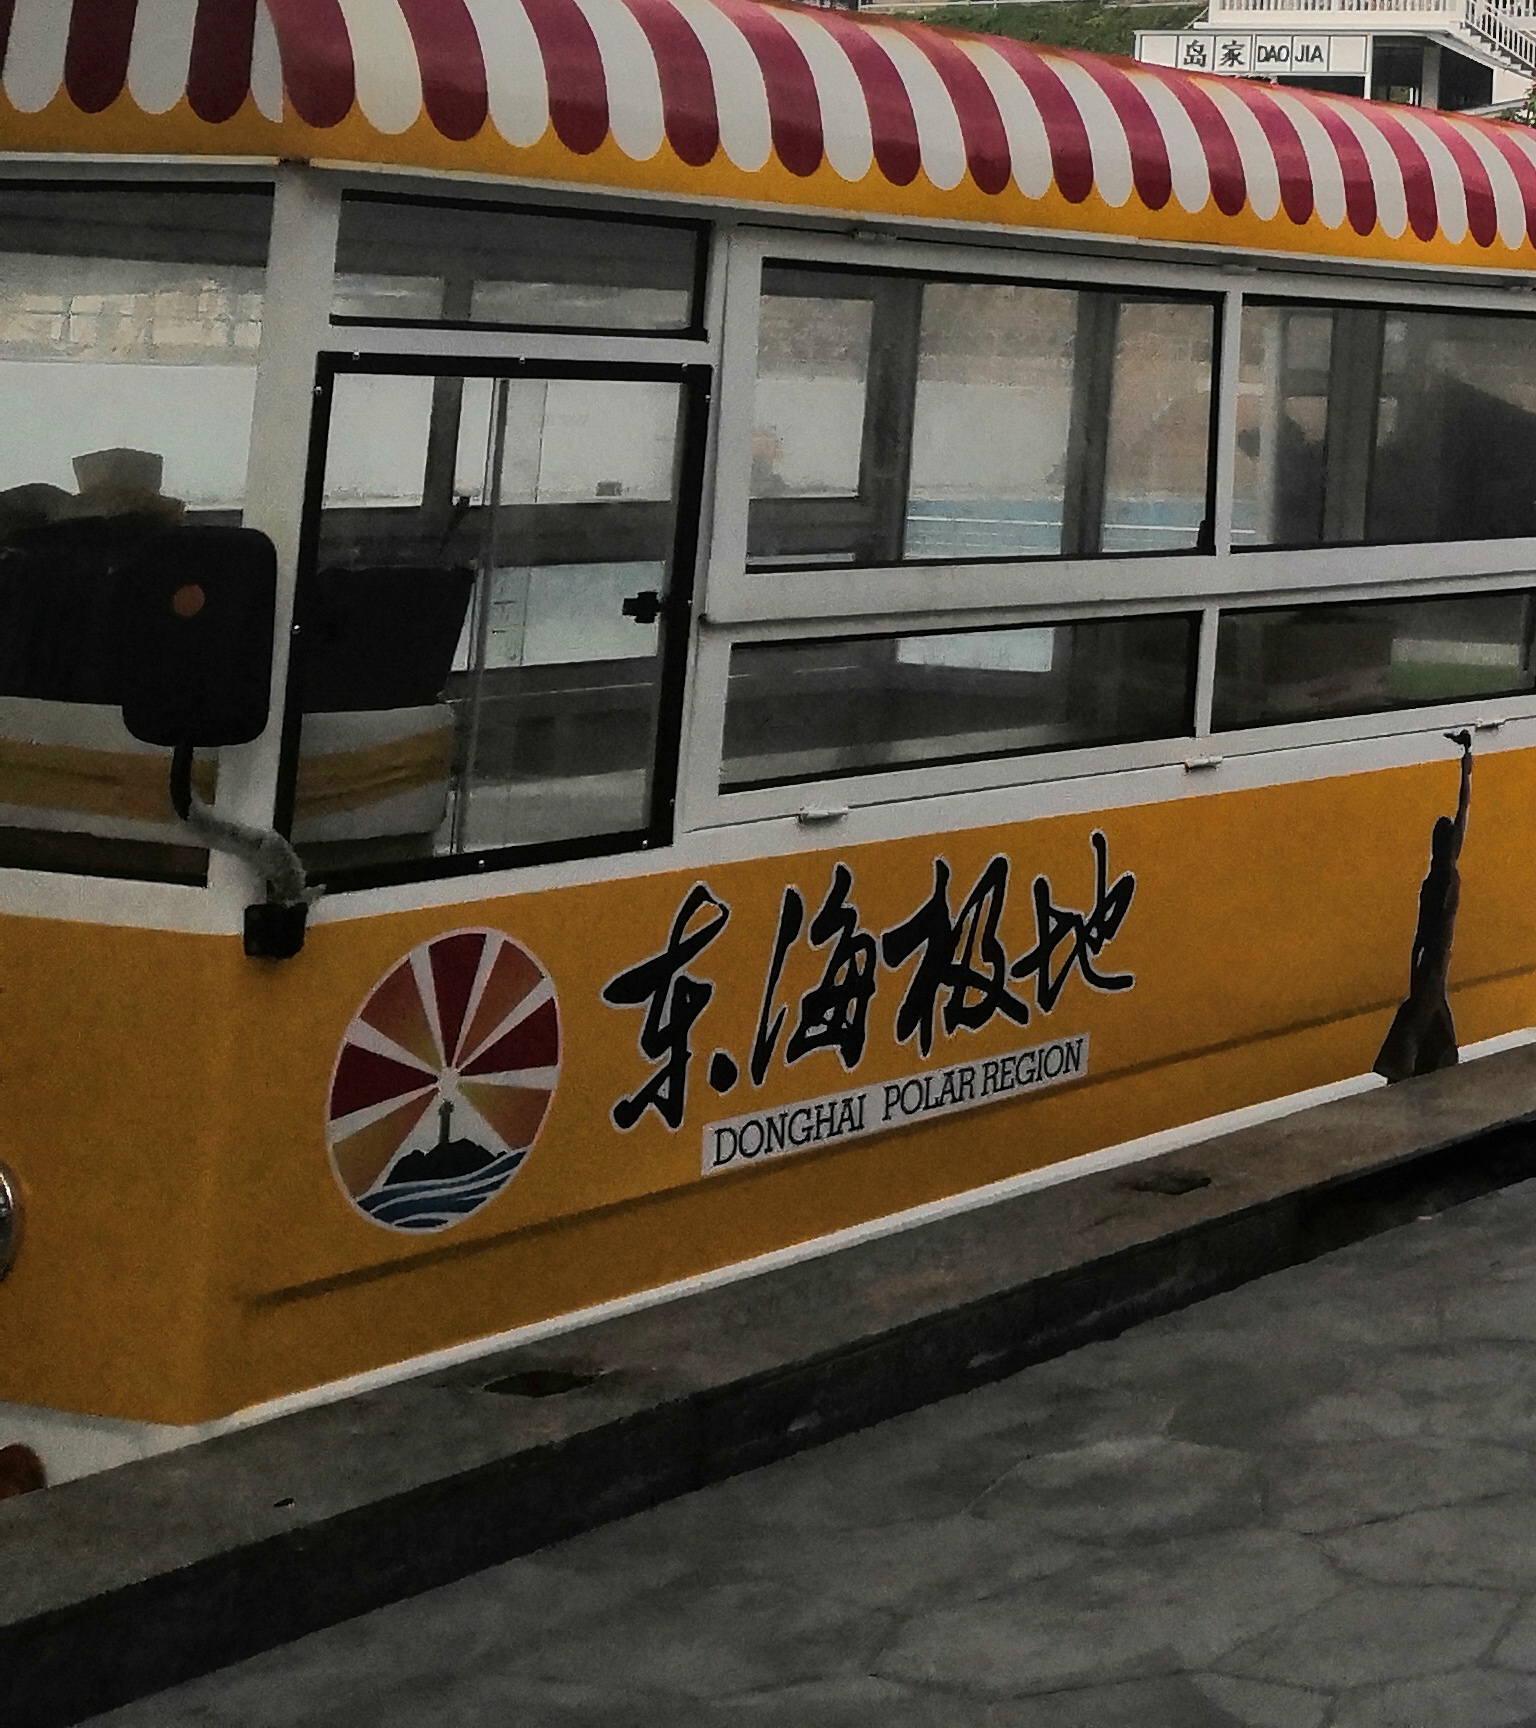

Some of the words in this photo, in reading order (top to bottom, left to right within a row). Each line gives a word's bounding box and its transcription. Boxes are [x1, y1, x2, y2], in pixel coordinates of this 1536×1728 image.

[1184, 39, 1246, 67] 岛家
[1257, 45, 1290, 63] DAO
[1295, 44, 1324, 63] JIA
[601, 829, 1136, 1131] 东海极地
[712, 1094, 868, 1167] DONGHAI
[881, 1067, 976, 1122] POLAR
[981, 1038, 1085, 1097] REGION
